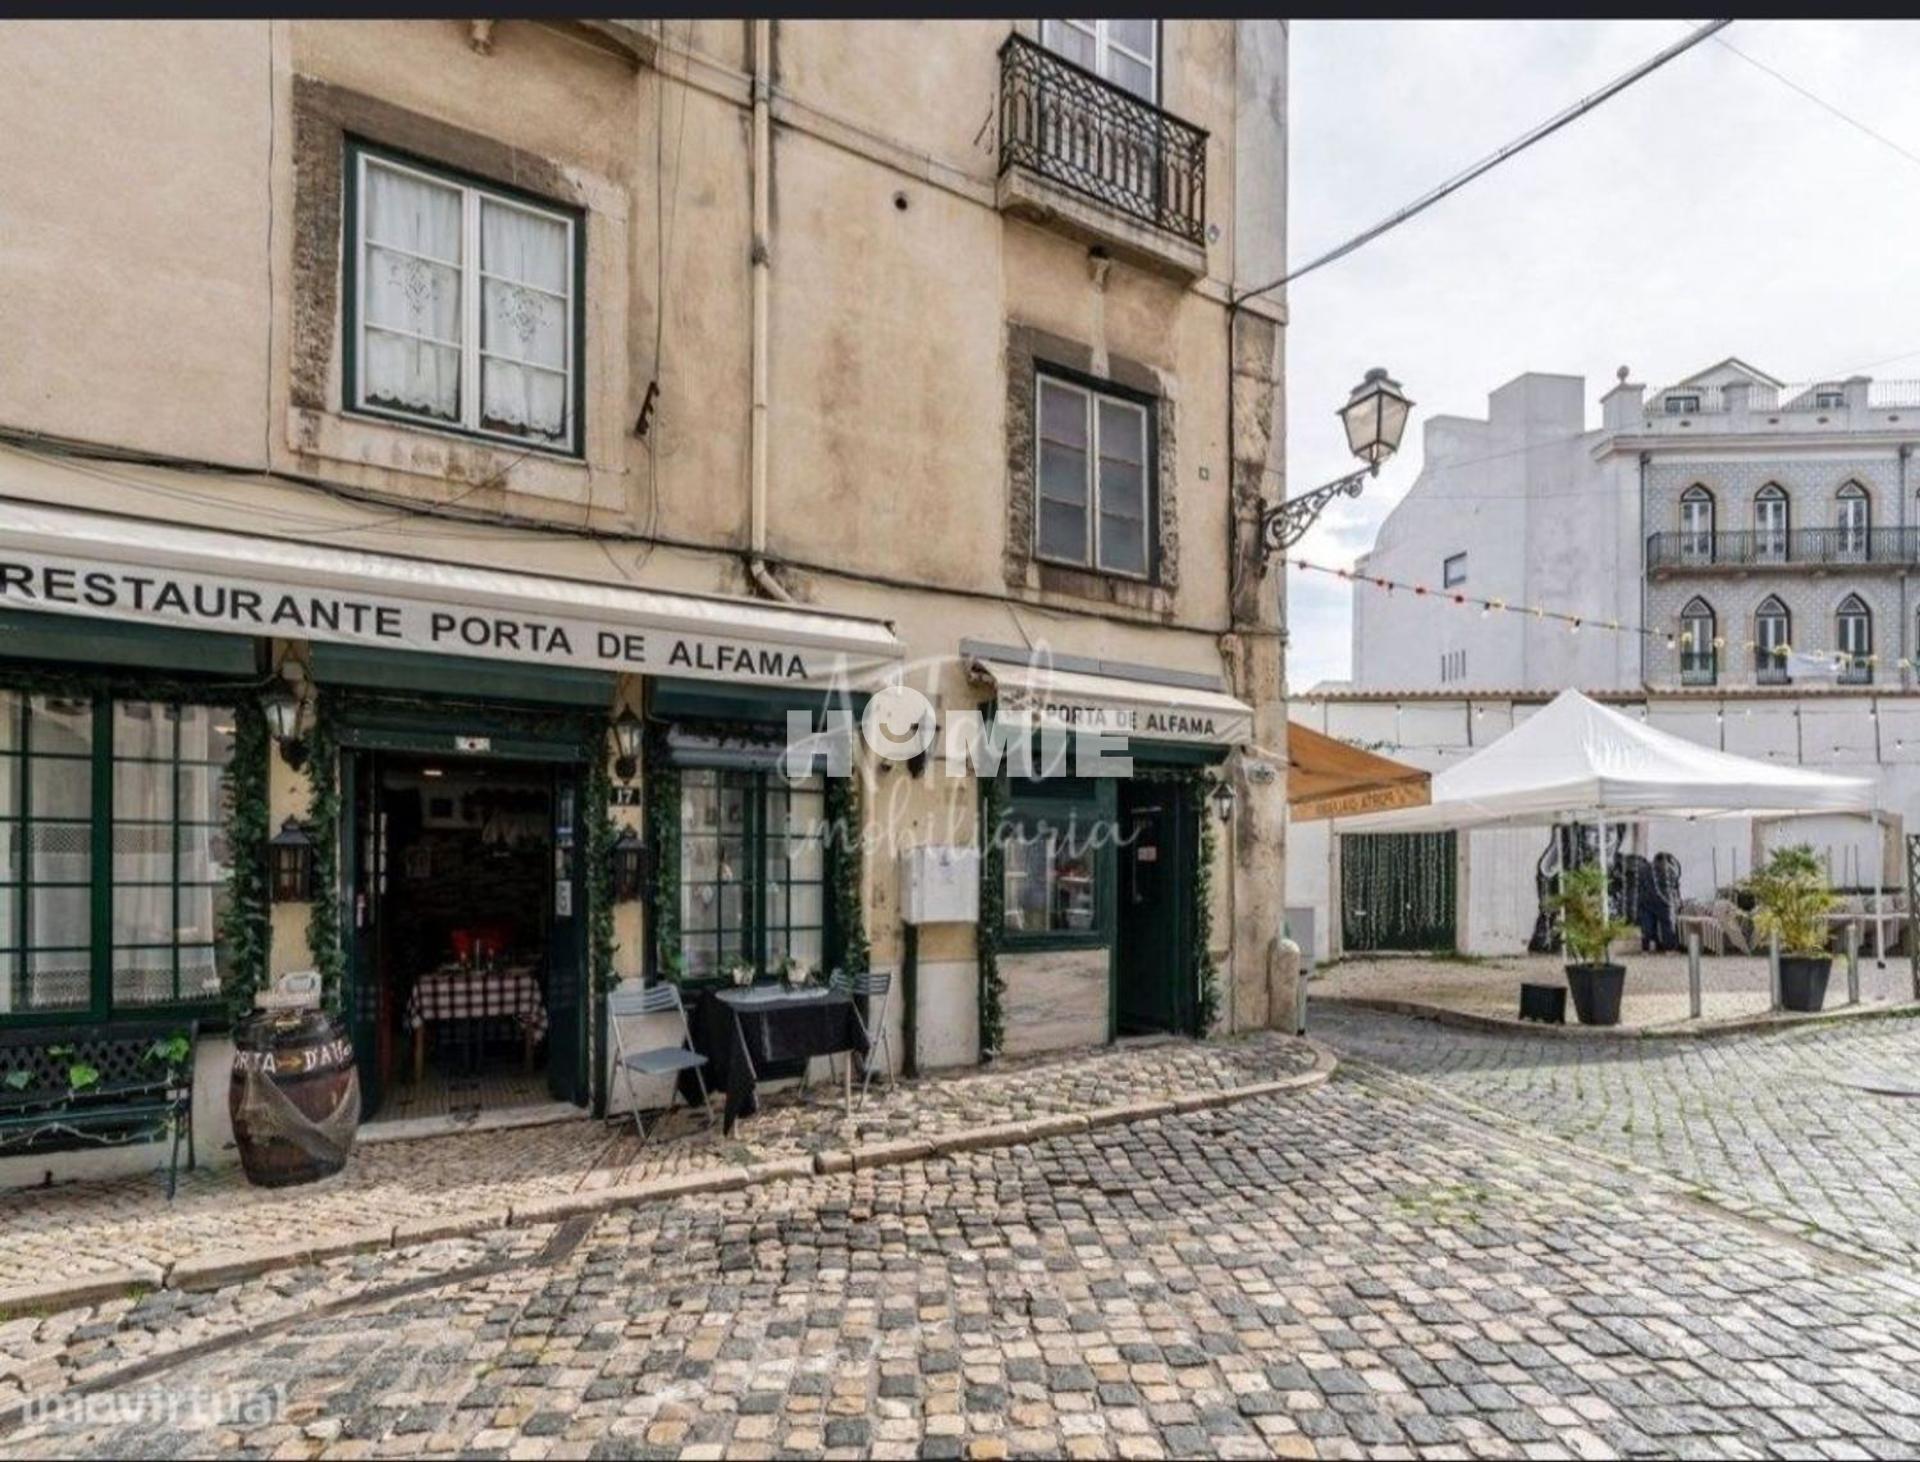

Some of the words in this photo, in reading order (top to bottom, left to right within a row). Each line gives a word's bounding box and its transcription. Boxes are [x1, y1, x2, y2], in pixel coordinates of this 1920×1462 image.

[0, 562, 403, 638] RESTAURANTE
[431, 612, 573, 656] PORTA
[597, 631, 646, 663] DE
[668, 640, 809, 679] ALFAMA
[1046, 703, 1107, 728] PORTA
[1116, 712, 1137, 730] DE
[1146, 713, 1216, 736] ALFAMA
[617, 788, 634, 804] 17
